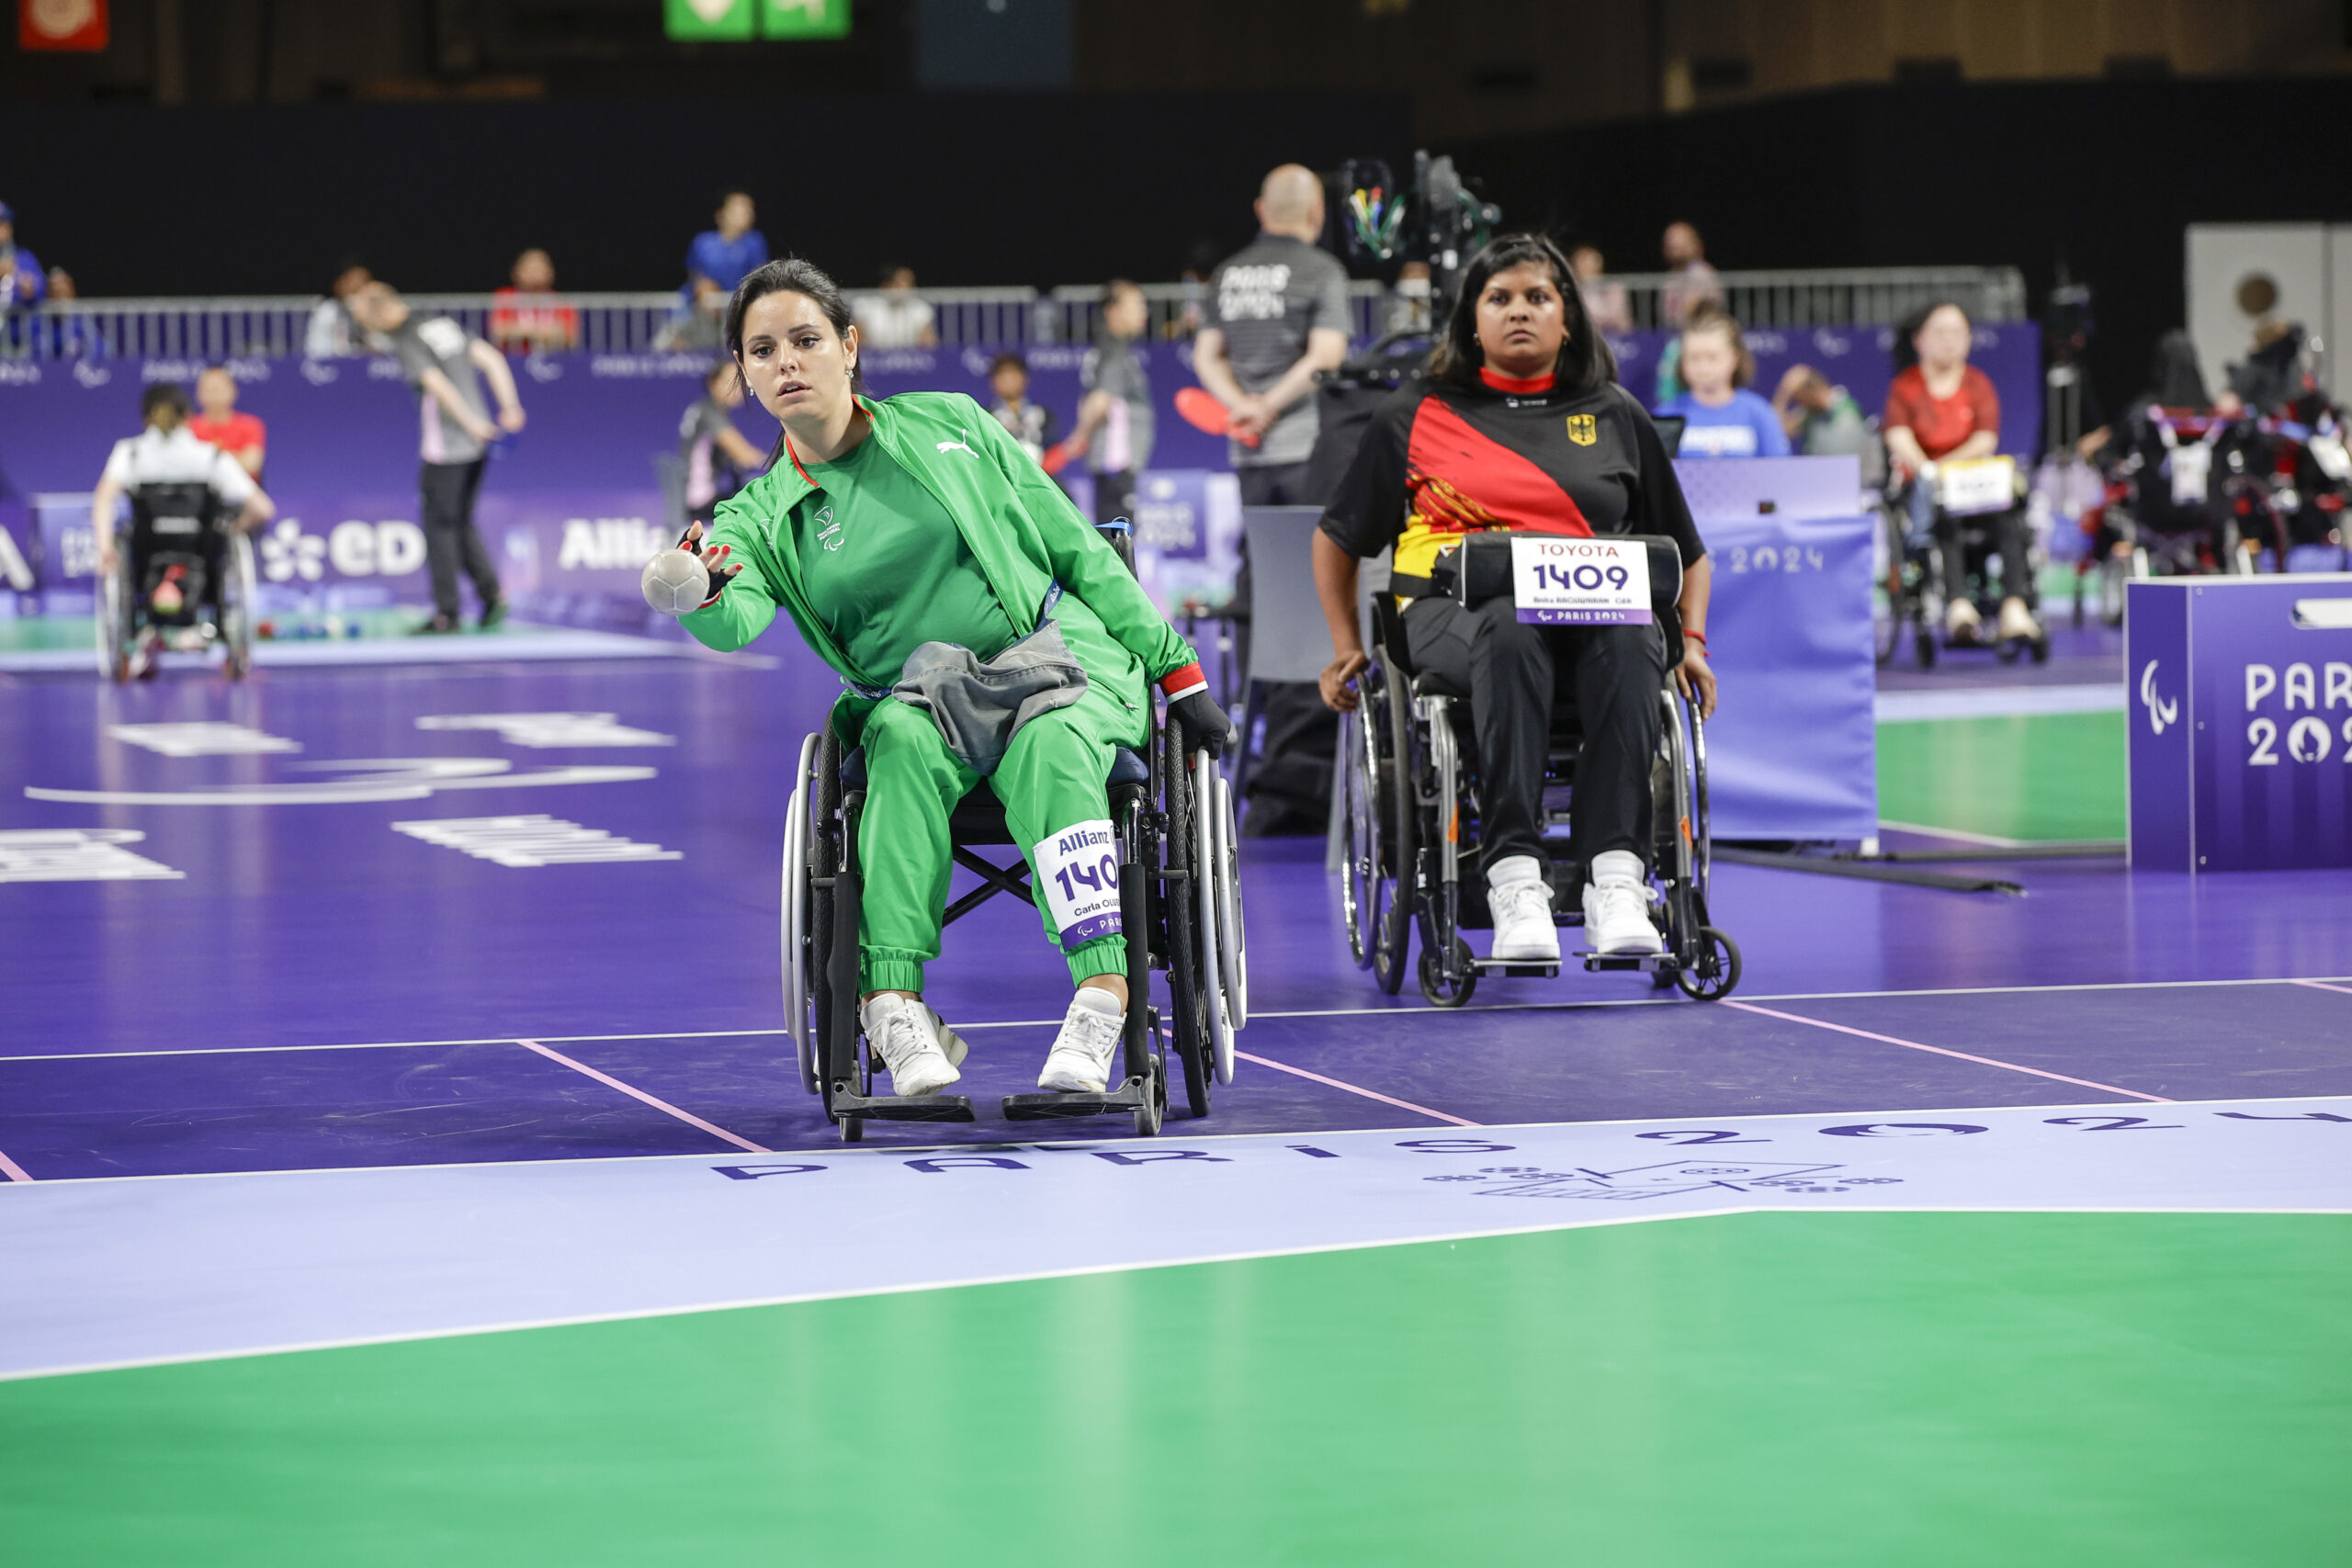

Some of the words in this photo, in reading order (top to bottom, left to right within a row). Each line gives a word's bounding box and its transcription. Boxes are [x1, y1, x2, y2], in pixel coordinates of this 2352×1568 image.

[1537, 544, 1620, 558] TOYOTA
[1730, 546, 1825, 573] 2024
[1533, 564, 1629, 591] 1409
[1557, 611, 1592, 621] PARIS
[1594, 611, 1626, 621] 2024
[1058, 830, 1110, 856] Allianz
[1074, 903, 1101, 917] Carla
[710, 1139, 1516, 1180] PARIS
[1634, 1111, 2352, 1145] 2024
